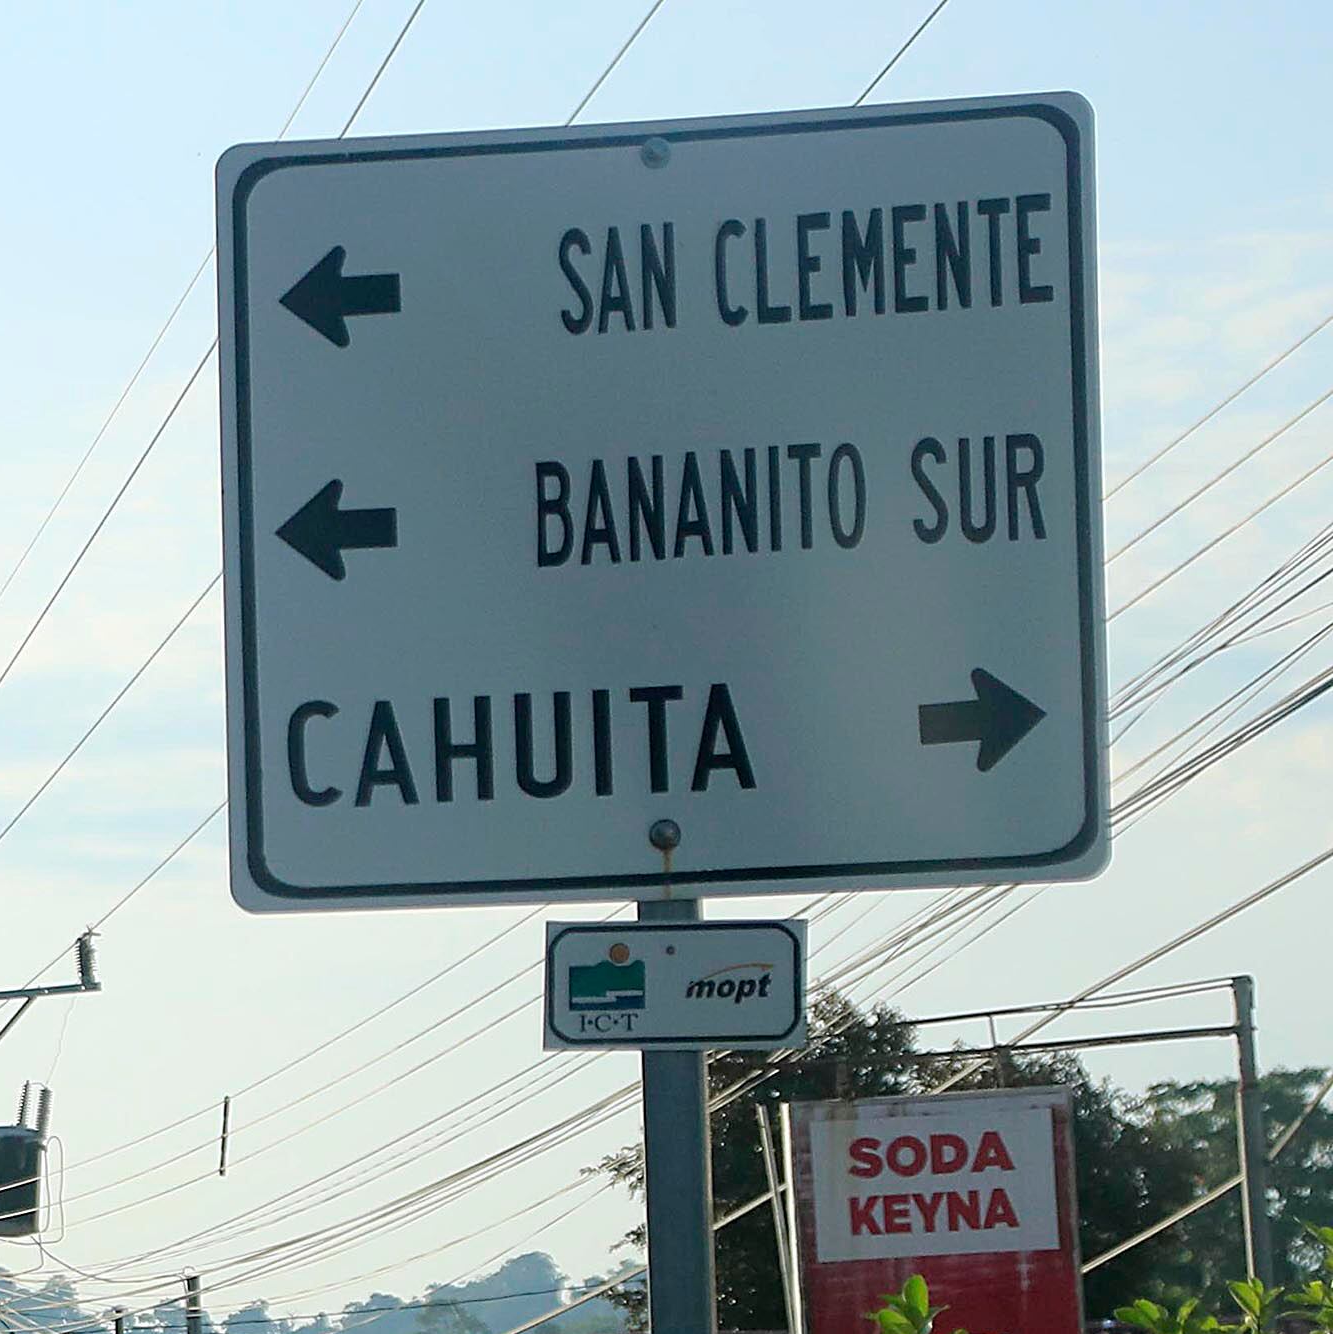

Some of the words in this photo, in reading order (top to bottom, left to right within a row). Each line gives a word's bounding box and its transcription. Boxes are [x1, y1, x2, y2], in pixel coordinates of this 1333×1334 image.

[557, 221, 677, 337] SAN
[714, 192, 1055, 328] CLEMENTE
[534, 442, 867, 569] BANANITO
[910, 432, 1048, 546] SUR
[286, 682, 759, 809] CAHUITA
[685, 971, 773, 1003] mopt
[847, 1130, 1016, 1180] SODA
[847, 1187, 1021, 1237] KEYNA
